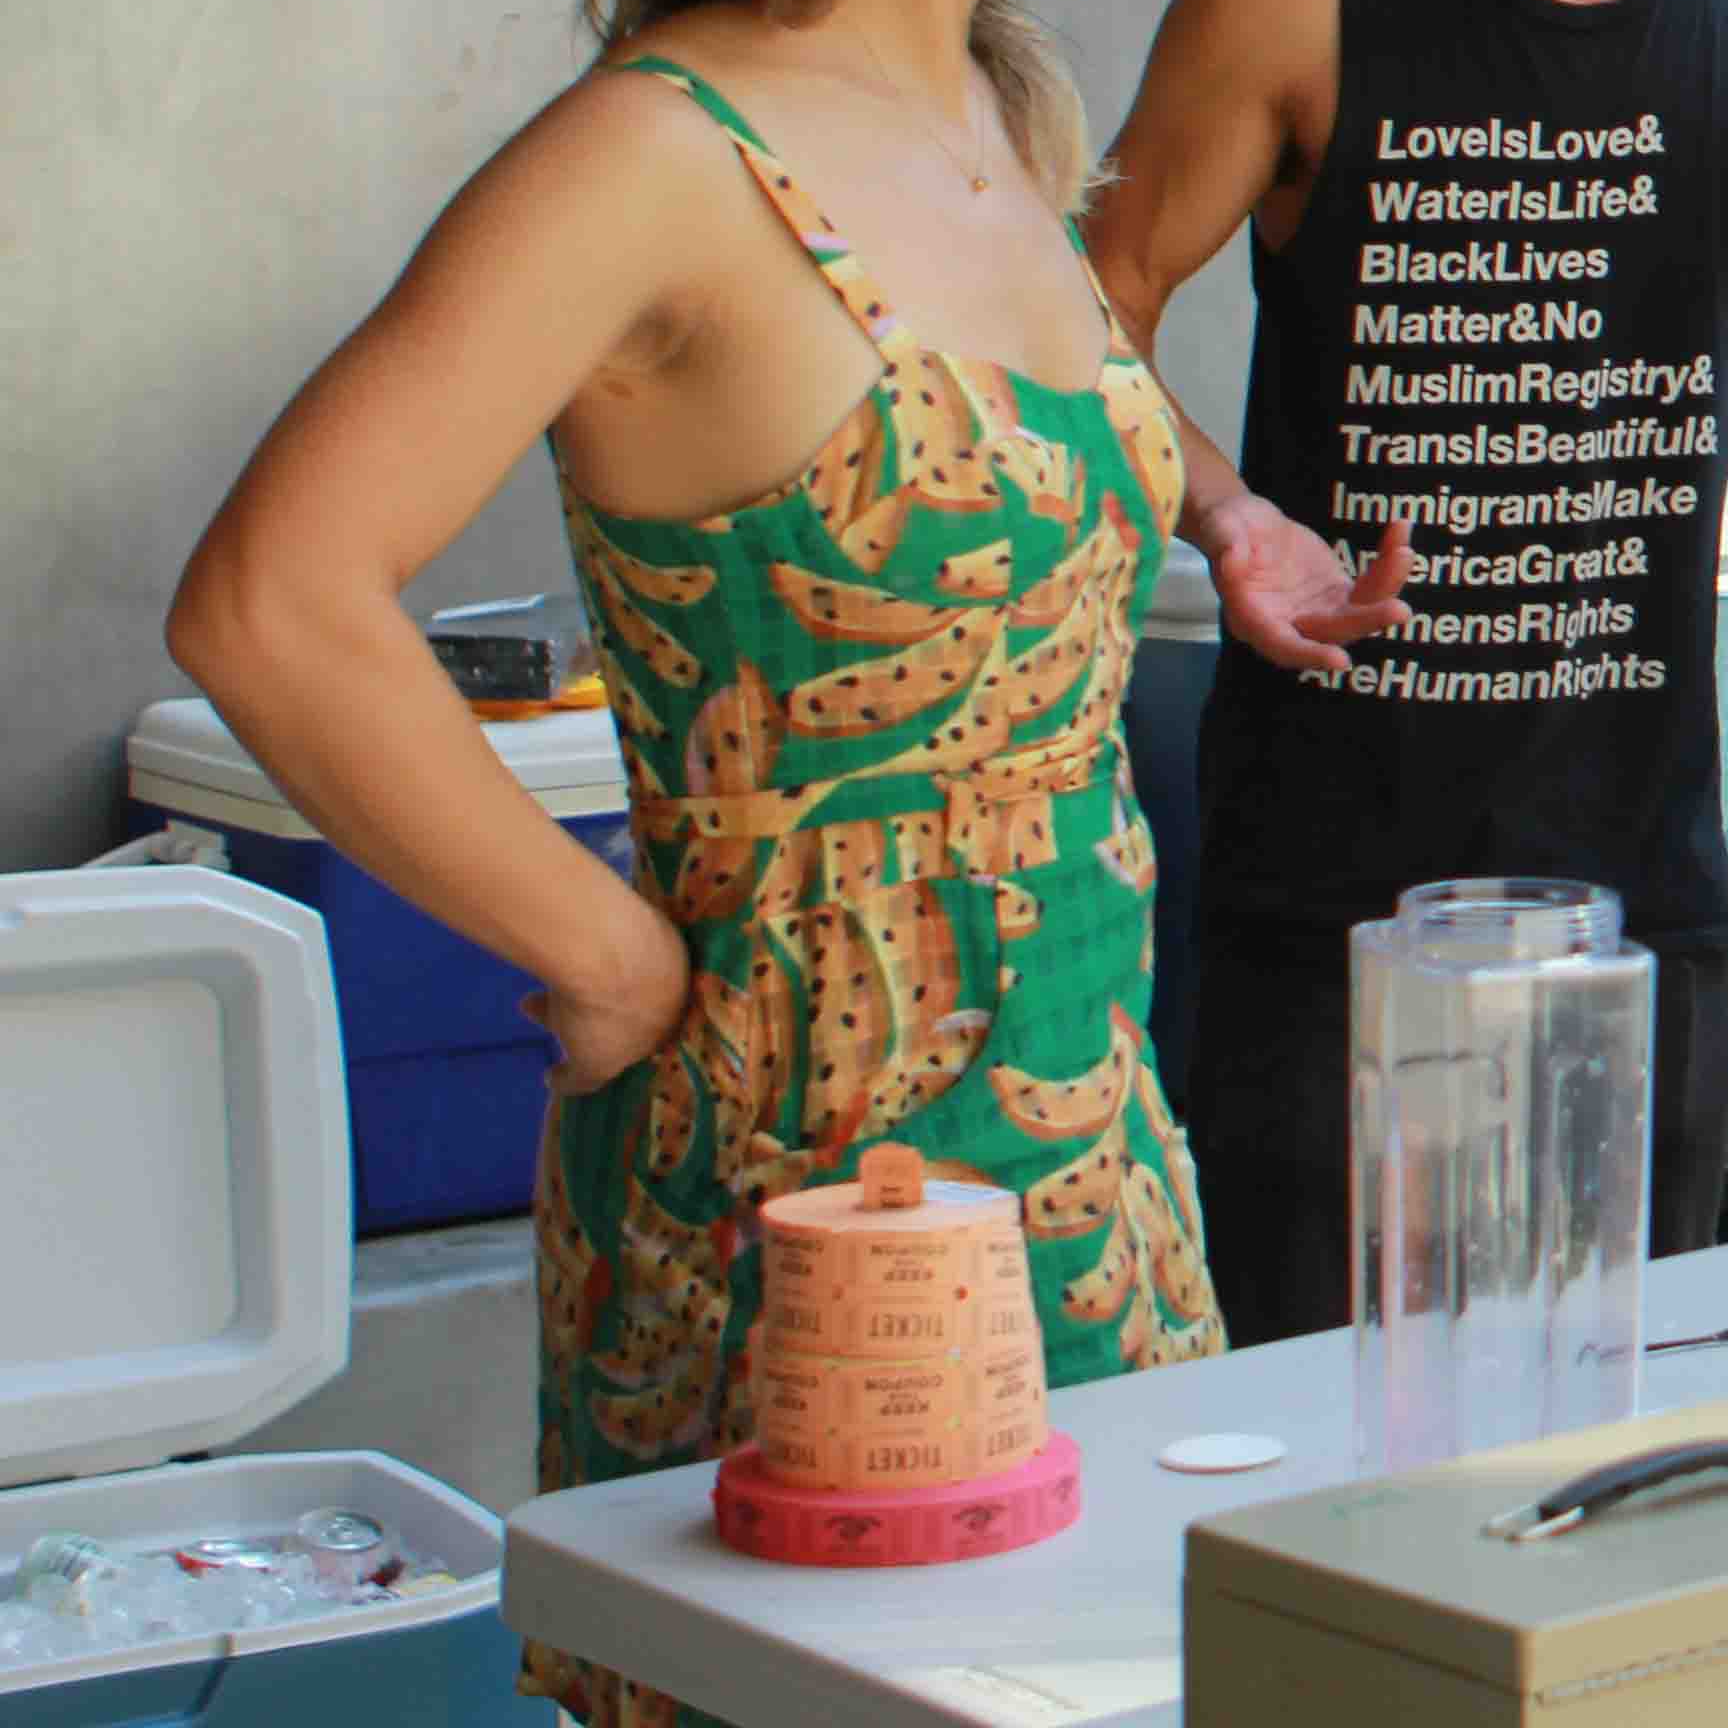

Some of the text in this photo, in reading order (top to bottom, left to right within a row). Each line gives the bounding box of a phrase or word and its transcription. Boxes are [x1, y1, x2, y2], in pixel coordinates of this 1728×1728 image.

[1377, 114, 1665, 161] LoveIsLove&
[1368, 174, 1659, 224] WaterIsLife&
[1359, 241, 1610, 285] BlackLives
[1352, 300, 1604, 345] Matter&No
[1345, 354, 1716, 409] MuslimRegistry&
[1340, 415, 1721, 466] TransIsBeautiful&
[1371, 597, 1635, 649] mensRights
[867, 1313, 945, 1339] TICKET
[865, 1444, 942, 1471] TICKET
